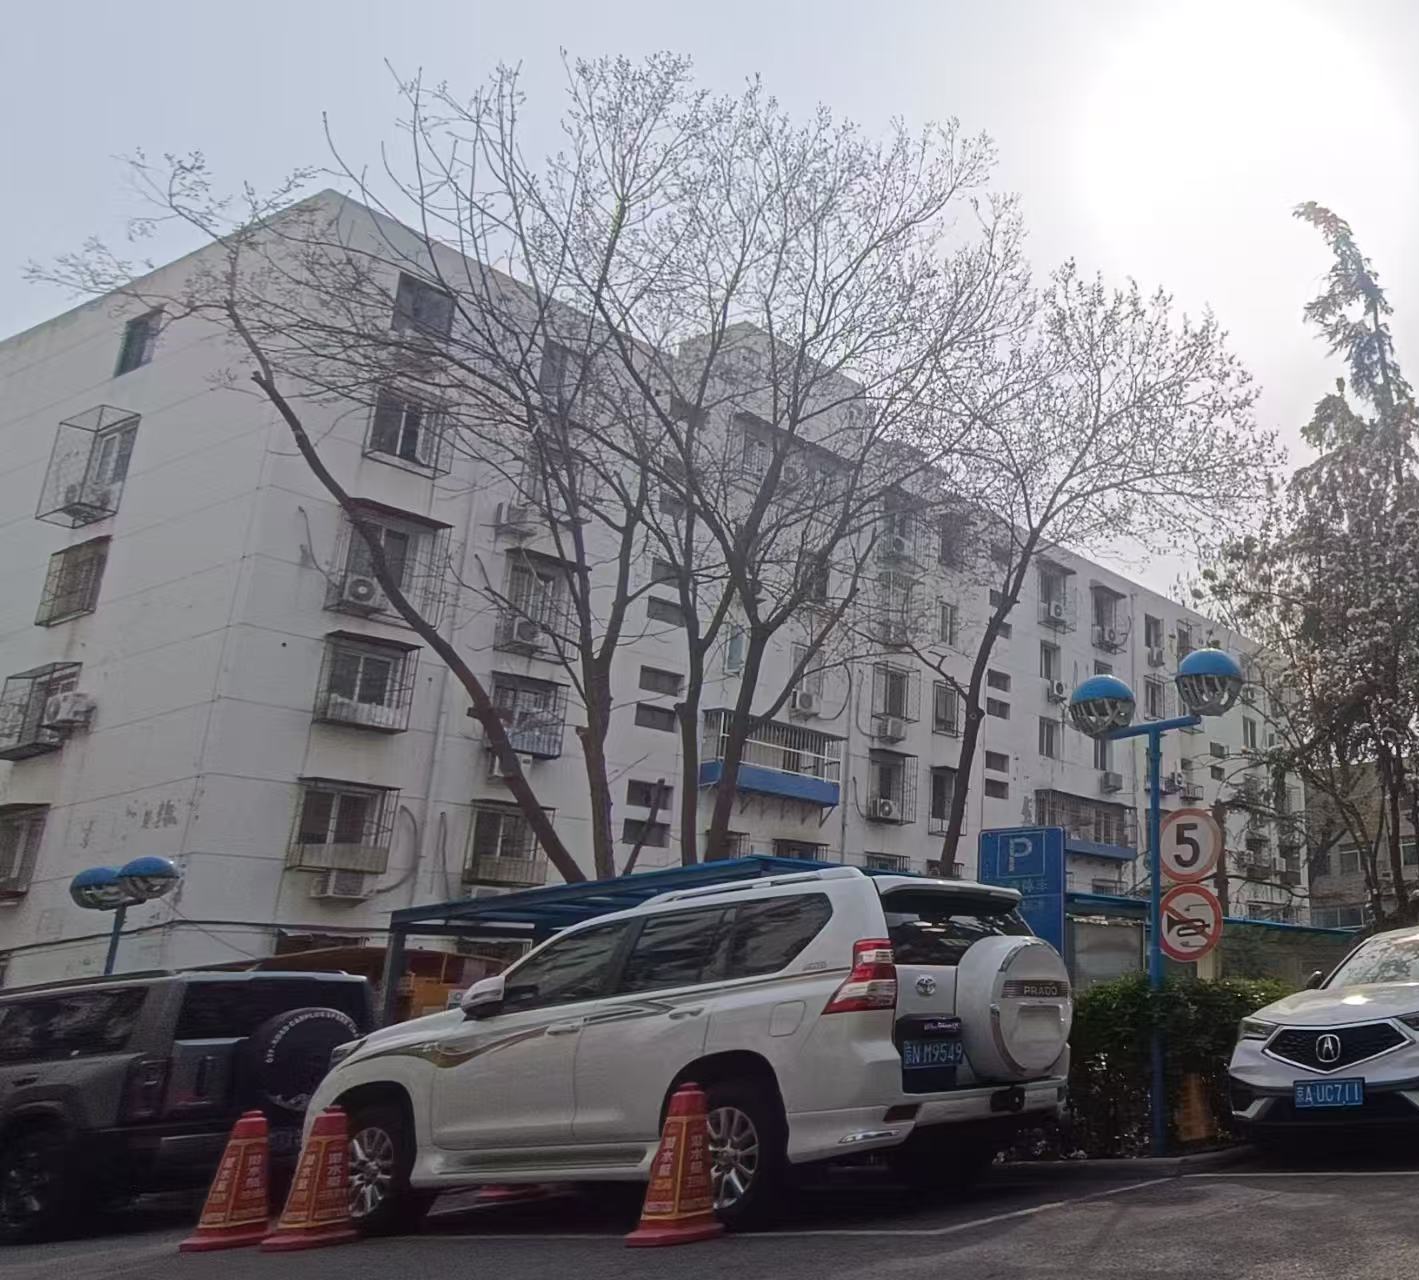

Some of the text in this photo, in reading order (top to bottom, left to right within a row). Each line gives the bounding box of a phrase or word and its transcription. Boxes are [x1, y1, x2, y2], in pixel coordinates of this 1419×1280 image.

[1008, 837, 1033, 873] P
[1173, 822, 1201, 868] 5
[1023, 984, 1058, 997] PRADO
